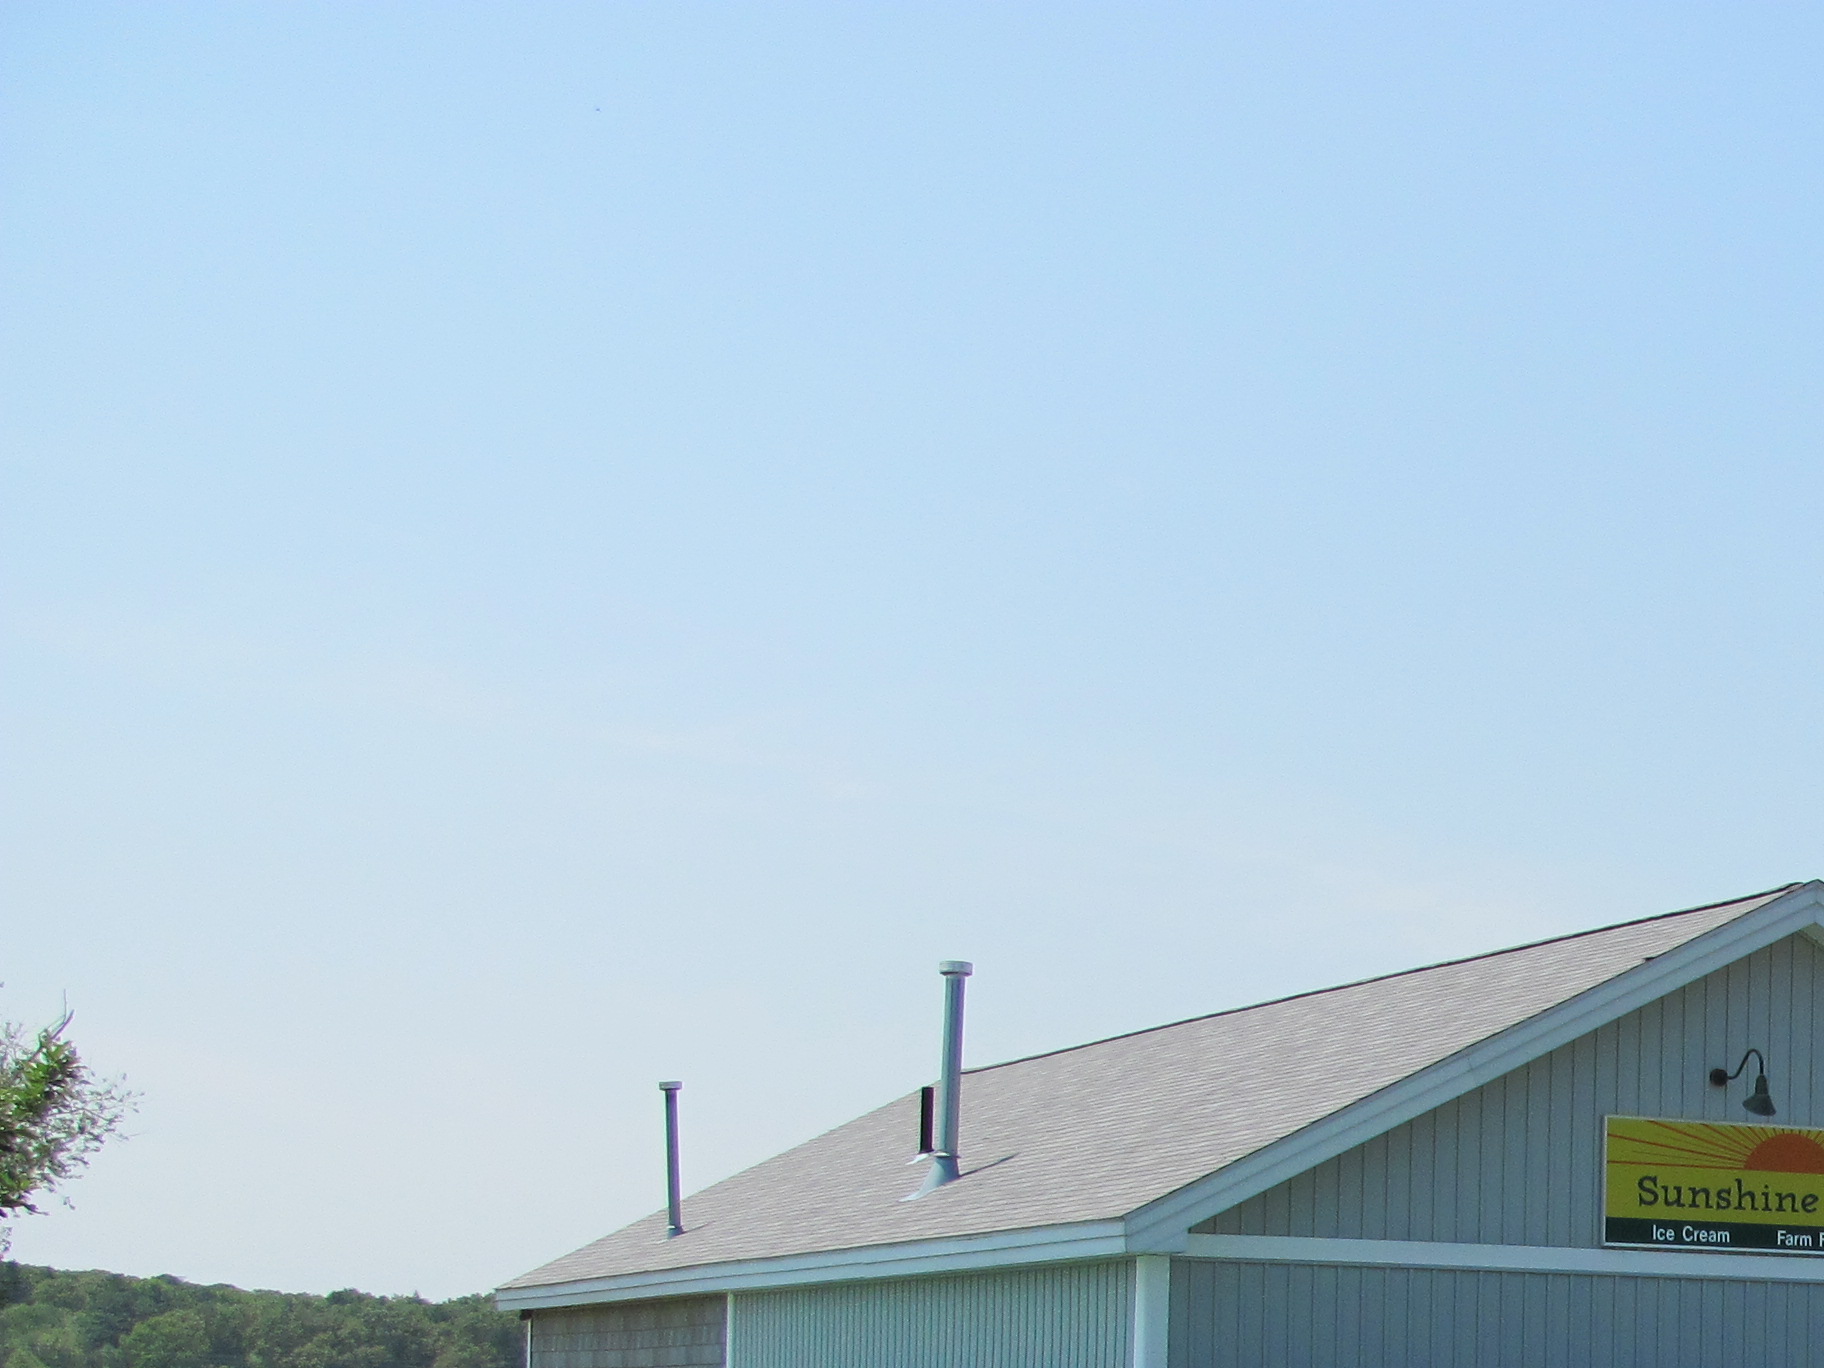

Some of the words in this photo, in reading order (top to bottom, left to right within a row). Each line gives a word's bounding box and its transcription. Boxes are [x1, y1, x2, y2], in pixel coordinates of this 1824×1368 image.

[1637, 1175, 1819, 1213] Sunshine
[1652, 1224, 1675, 1241] Ice
[1682, 1225, 1730, 1243] Cream
[1777, 1230, 1812, 1247] Farm
